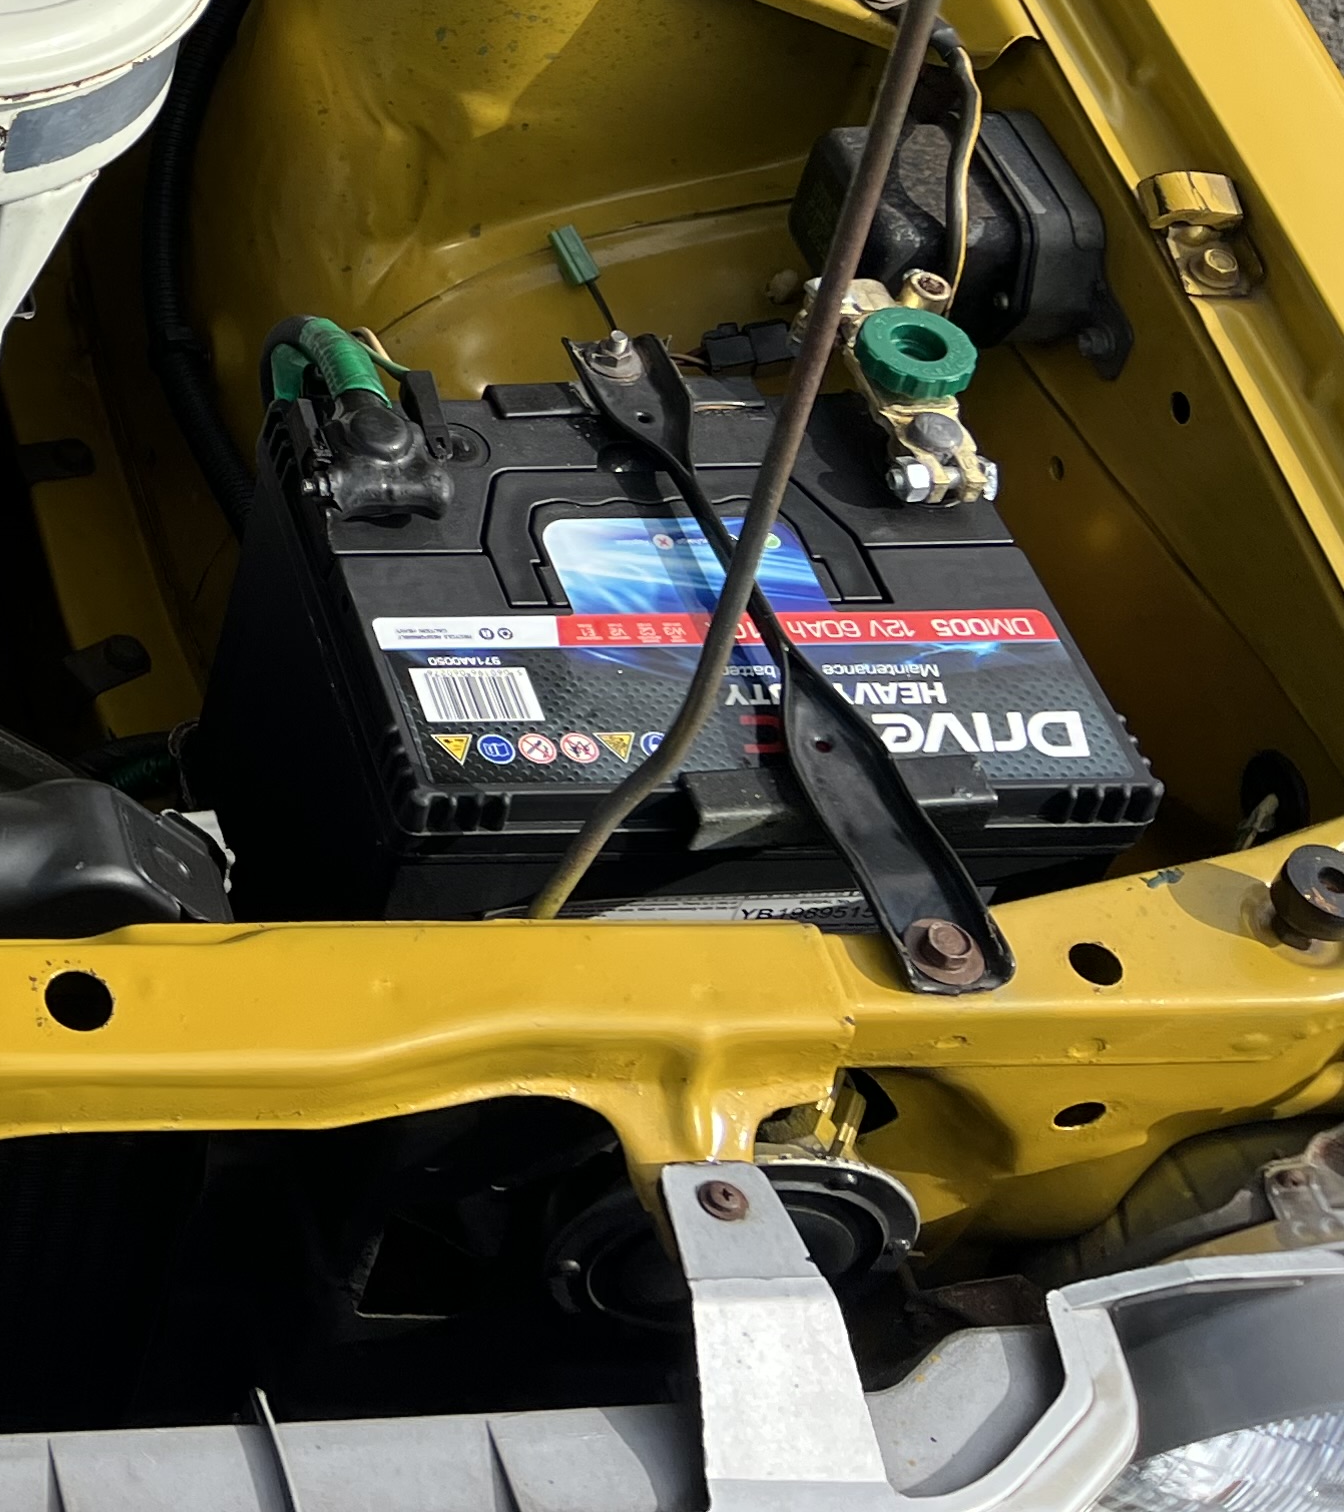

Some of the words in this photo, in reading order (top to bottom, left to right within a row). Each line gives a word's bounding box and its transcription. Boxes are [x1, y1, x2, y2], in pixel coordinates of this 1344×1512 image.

[787, 619, 863, 639] 60Ah
[869, 618, 917, 638] 12V
[934, 616, 1035, 638] DM005
[721, 665, 777, 679] batter
[820, 663, 941, 678] Maintenance
